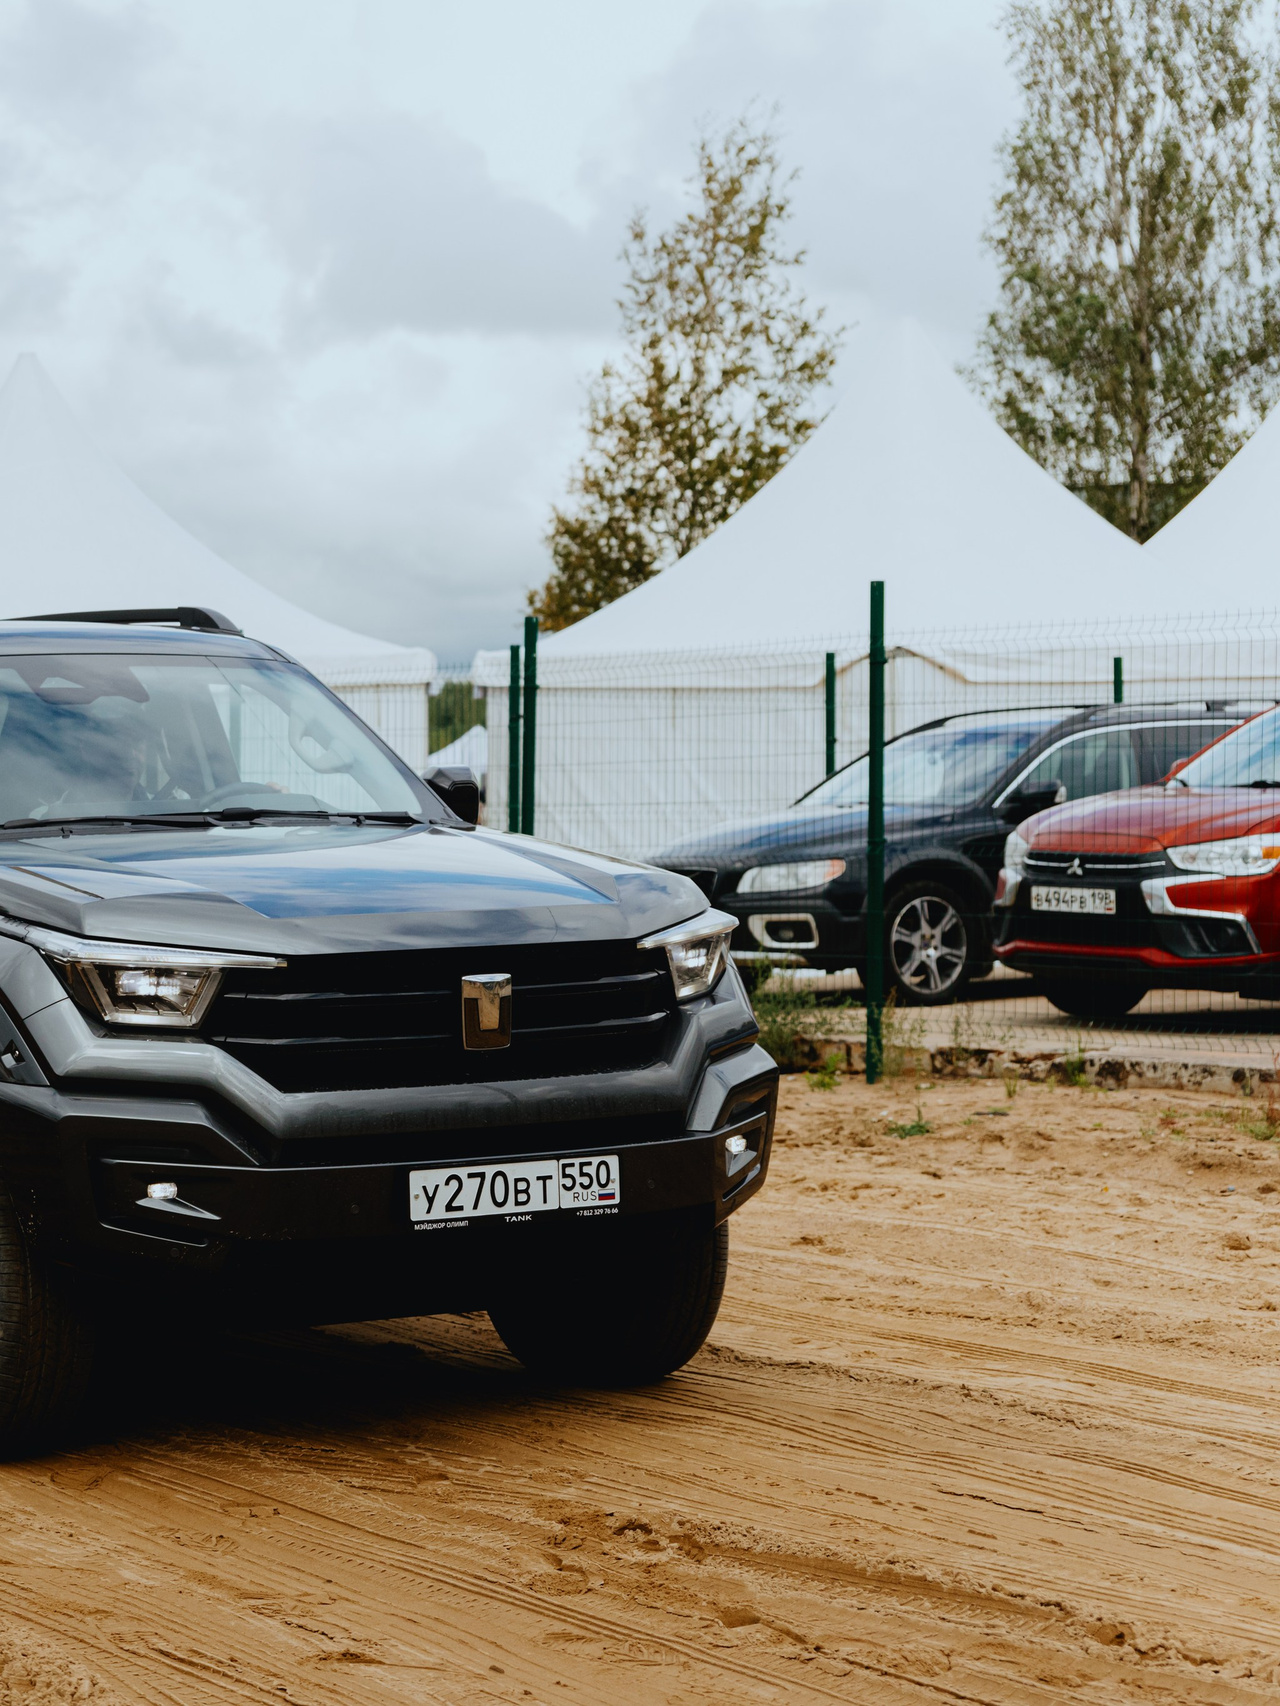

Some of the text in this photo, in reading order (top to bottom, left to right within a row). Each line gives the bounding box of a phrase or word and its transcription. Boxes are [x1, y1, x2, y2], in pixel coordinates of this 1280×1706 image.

[561, 1159, 611, 1192] 550
[421, 1169, 554, 1215] У270ВТ
[573, 1190, 597, 1202] RUS
[504, 1214, 532, 1223] TANK
[414, 1220, 469, 1231] МЭЙДЖОР ОЛИМП
